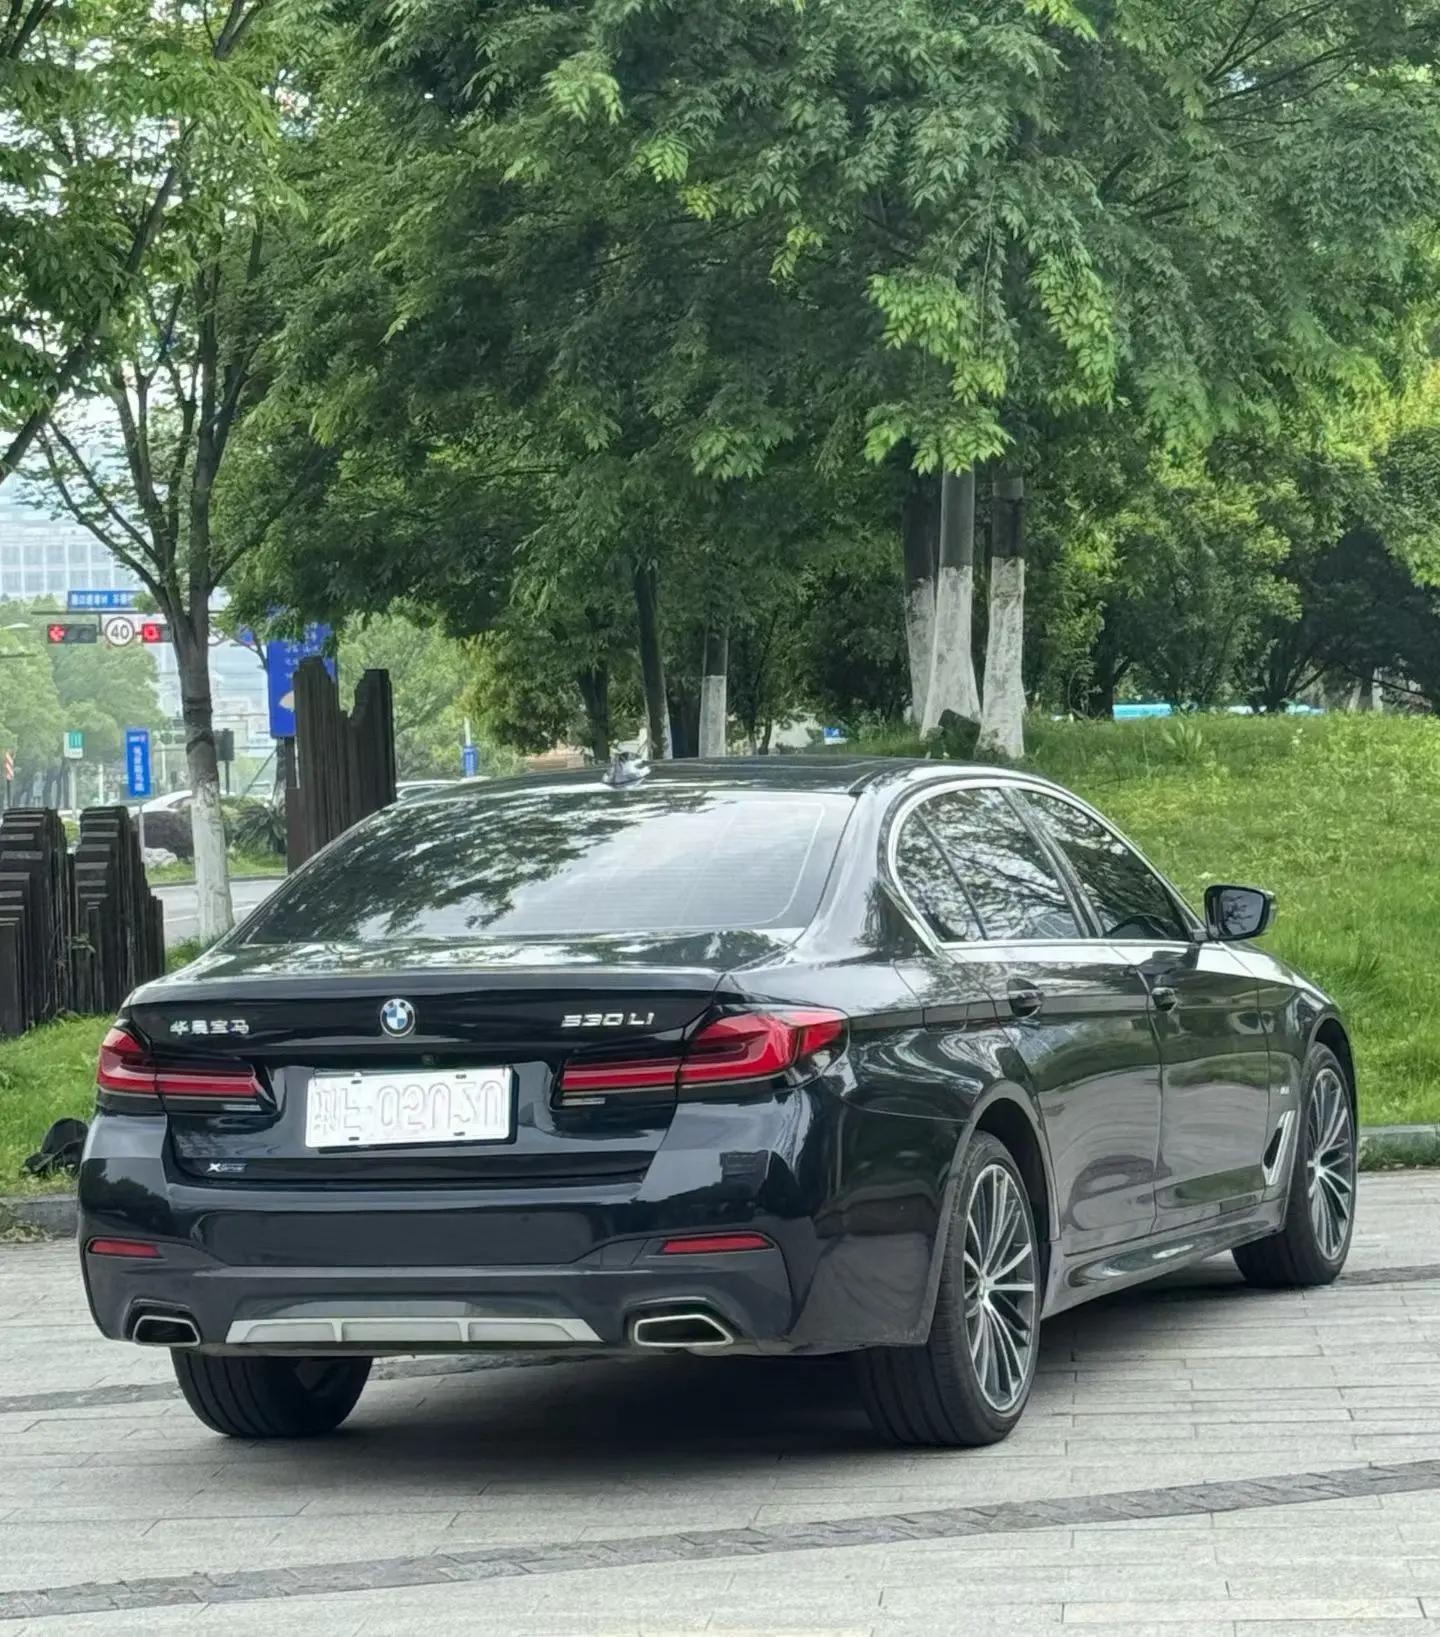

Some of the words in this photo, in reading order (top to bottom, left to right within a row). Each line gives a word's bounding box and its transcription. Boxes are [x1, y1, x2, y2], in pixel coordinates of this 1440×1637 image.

[111, 624, 130, 640] 40
[169, 1019, 250, 1036] 华晨宝马
[561, 1013, 624, 1028] 530
